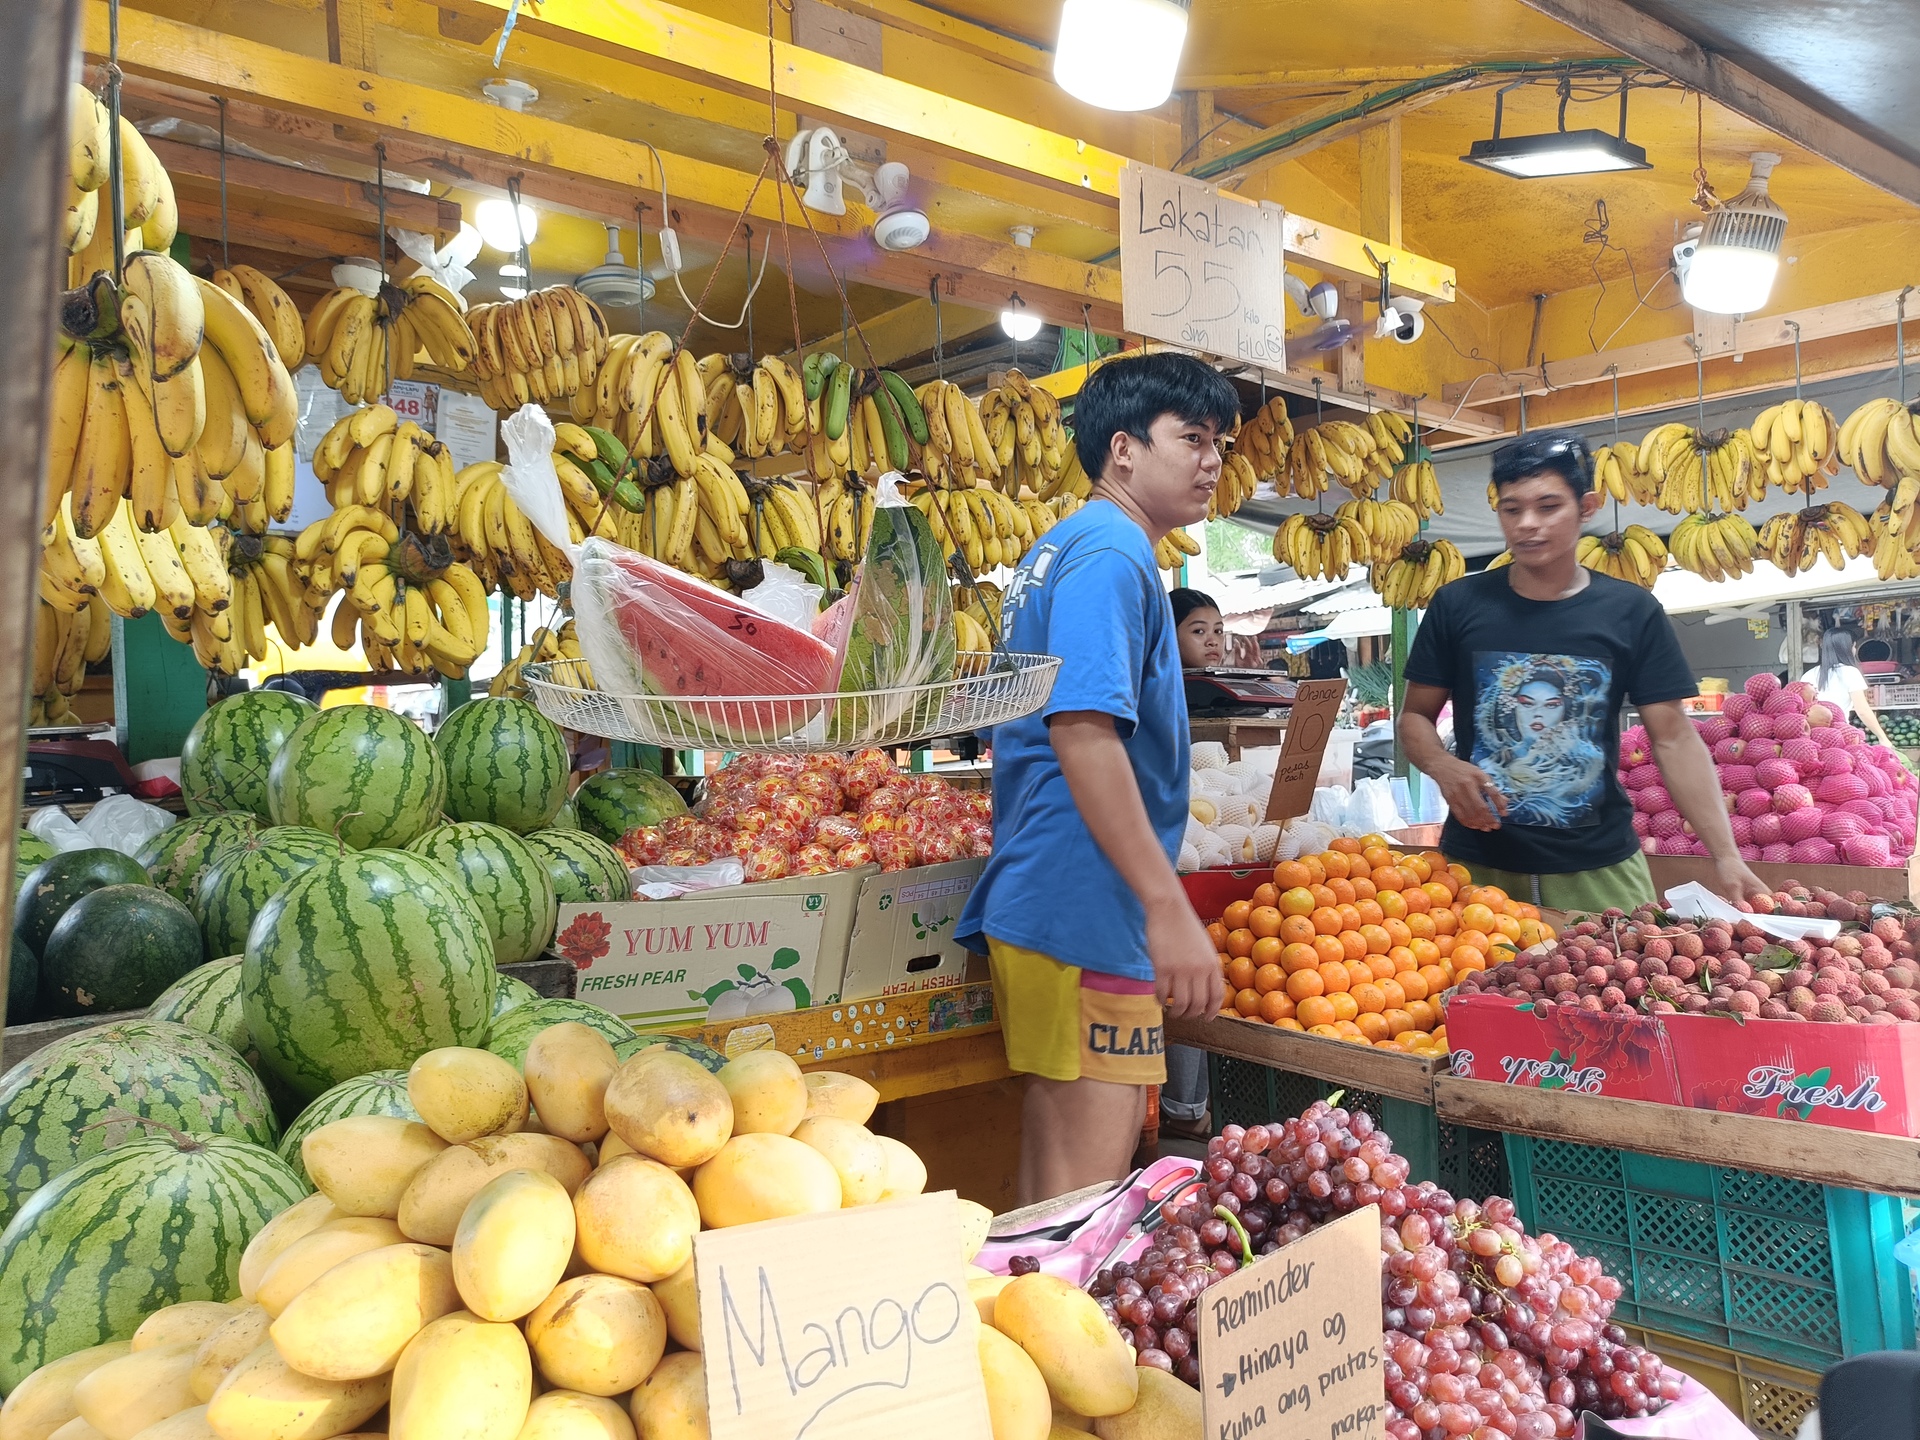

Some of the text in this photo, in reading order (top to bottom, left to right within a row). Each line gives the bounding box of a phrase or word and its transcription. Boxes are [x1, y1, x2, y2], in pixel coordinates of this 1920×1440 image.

[1139, 176, 1265, 257] Lakatan
[1150, 249, 1241, 323] 55
[1243, 306, 1260, 325] kilo
[1181, 322, 1209, 351] ang
[1298, 684, 1339, 706] Orange
[1285, 713, 1325, 759] 10
[1284, 770, 1304, 783] each
[623, 920, 771, 957] YUM YUM
[580, 969, 687, 993] FRESH PEAR
[921, 972, 961, 990] FRESH
[1499, 1055, 1607, 1095] Fresh
[1742, 1065, 1887, 1113] Fresh
[1211, 1259, 1315, 1337] Reminder
[718, 1264, 960, 1440] Mango
[1239, 1311, 1346, 1385] Hinaya og
[1219, 1345, 1379, 1440] Kuha ang prutas
[1330, 1405, 1384, 1440] maka-
